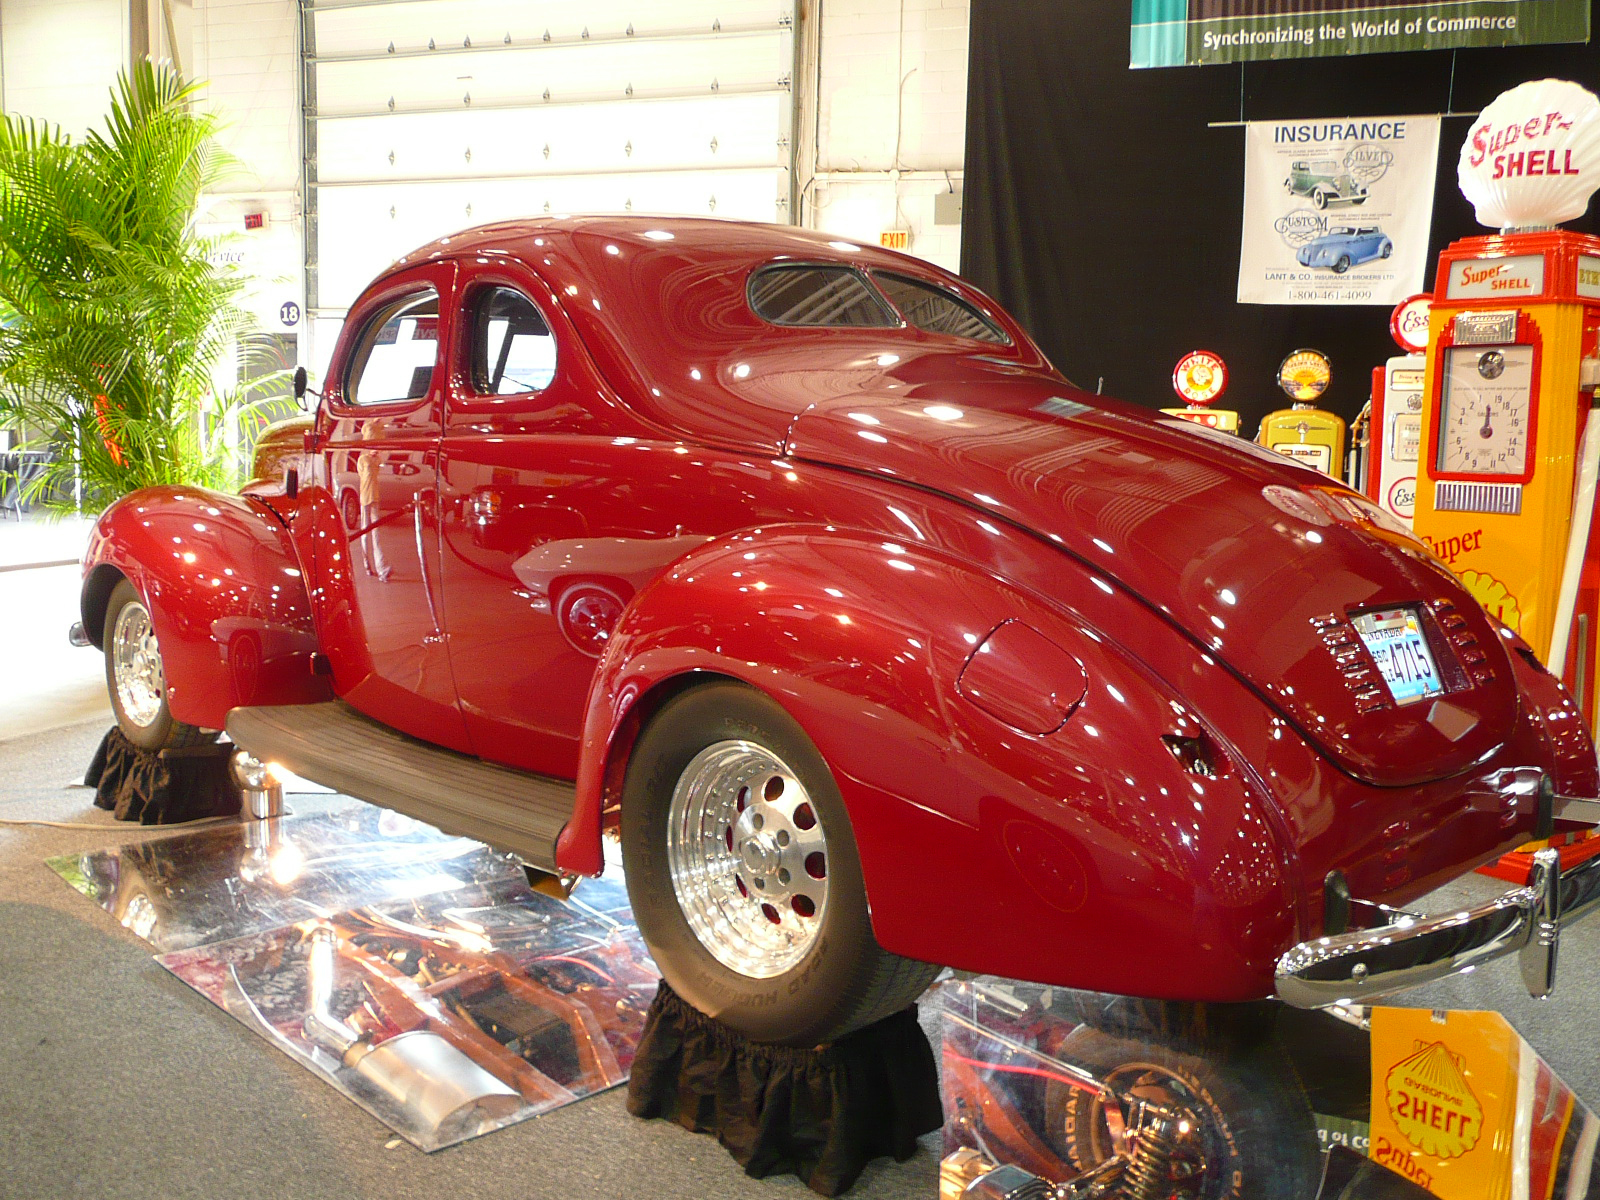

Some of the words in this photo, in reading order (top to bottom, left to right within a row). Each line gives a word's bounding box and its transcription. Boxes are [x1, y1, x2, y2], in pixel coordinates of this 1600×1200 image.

[1203, 25, 1314, 50] Synchronizing
[1319, 23, 1346, 40] the
[1351, 18, 1399, 38] World
[1404, 17, 1422, 35] of
[1426, 15, 1516, 33] Commerce
[1274, 122, 1406, 143] INSURANCE
[1492, 149, 1579, 180] SHELL
[1274, 216, 1328, 233] CUSTOM
[881, 232, 906, 248] EXIT
[1265, 273, 1289, 281] LANT
[1289, 273, 1296, 281] &
[1298, 273, 1313, 281] CO.
[1491, 278, 1531, 290] SHELL
[1288, 290, 1372, 301] 1-800-461-4099
[281, 306, 298, 322] 18
[1403, 310, 1430, 333] Ess
[1180, 355, 1220, 373] WHITE
[1183, 388, 1216, 400] ROSE
[1494, 395, 1503, 403] 19
[1502, 402, 1510, 410] 18
[1510, 408, 1518, 417] 17
[1511, 418, 1519, 427] 16
[1509, 438, 1517, 446] 14
[1498, 453, 1506, 461] 12
[1507, 448, 1515, 456] 13
[1490, 460, 1496, 468] 11
[1389, 640, 1432, 684] 4715
